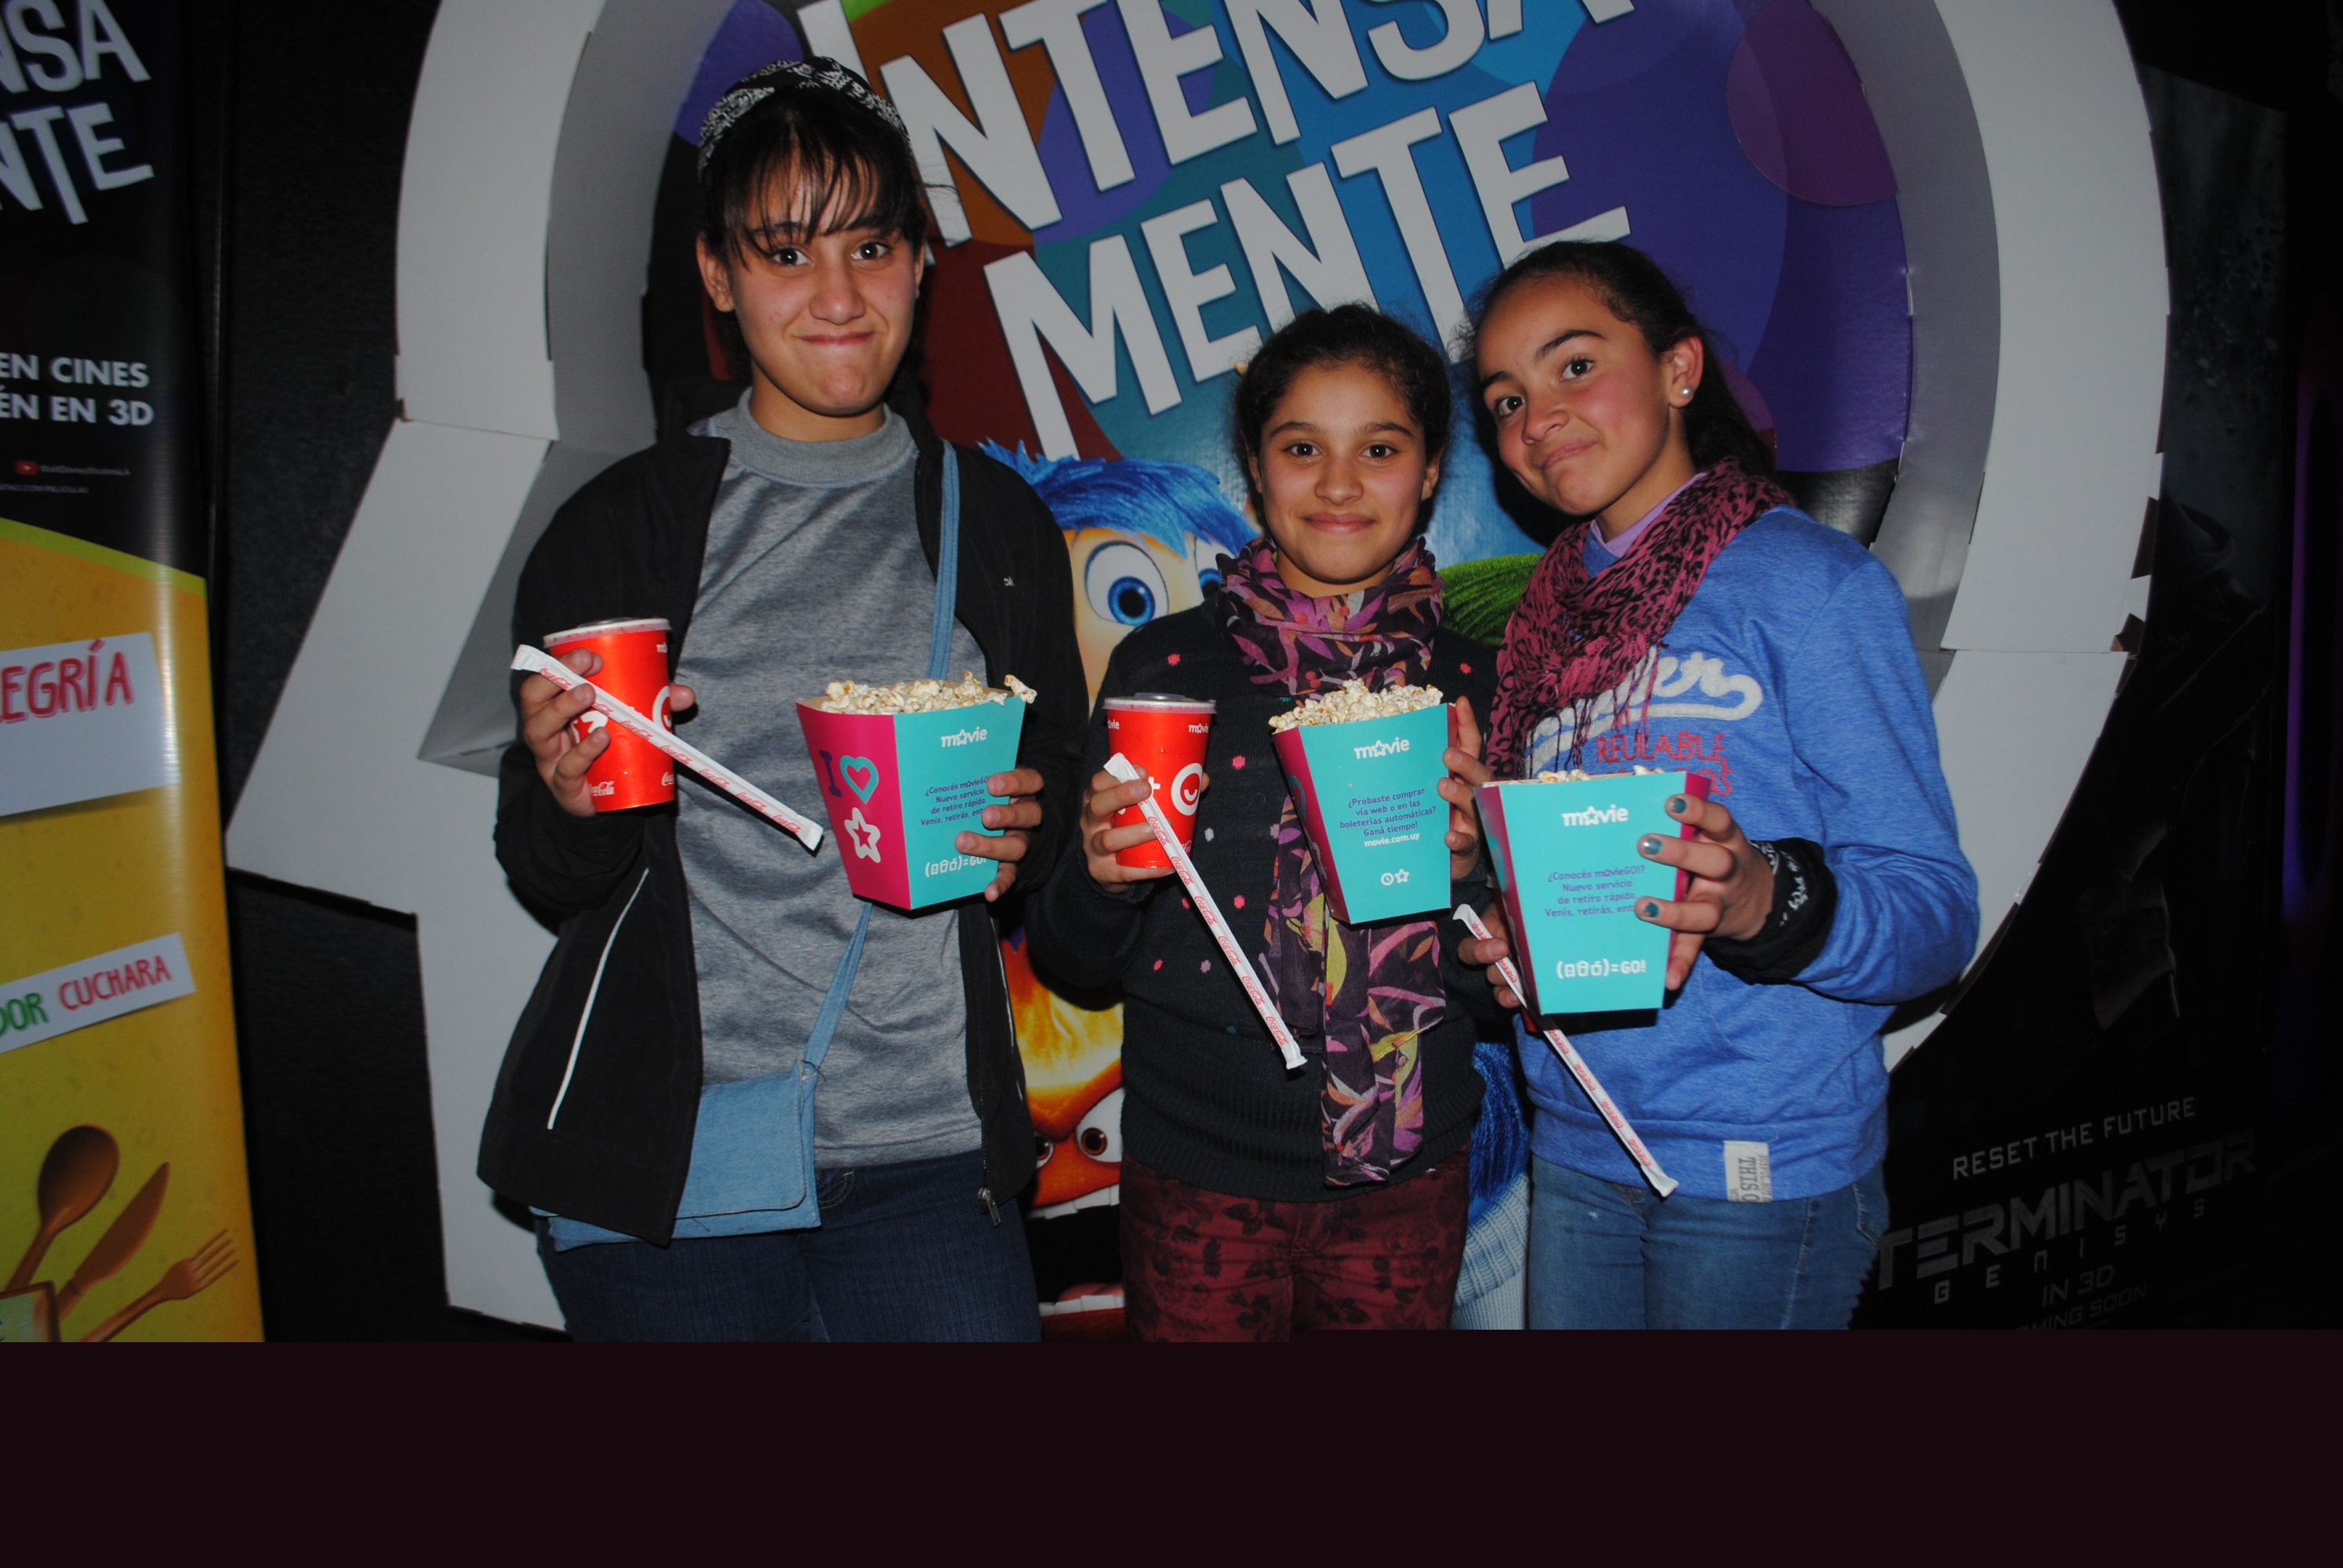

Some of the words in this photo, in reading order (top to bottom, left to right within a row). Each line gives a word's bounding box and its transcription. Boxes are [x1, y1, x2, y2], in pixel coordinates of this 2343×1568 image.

[49, 356, 151, 389] CINES
[49, 394, 98, 424] EN
[107, 398, 155, 426] 3D
[0, 638, 135, 724] EGRÍA
[935, 794, 958, 804] Nuevo
[960, 788, 985, 800] servicio
[943, 803, 963, 813] retiro
[1348, 794, 1390, 808] ¿Probaste
[1392, 788, 1426, 800] comprar
[1371, 804, 1388, 815] web
[1409, 800, 1421, 808] las
[1339, 817, 1382, 829] boleterías
[1384, 806, 1437, 823] automáticas?
[1364, 826, 1386, 837] Ganá
[1387, 821, 1419, 833] tiempo!
[1364, 833, 1420, 848] movie.com.uy
[1563, 884, 1593, 892] Nuevo
[1596, 879, 1633, 890] servicio
[1557, 896, 1570, 905] de
[1573, 895, 1602, 904] retiro
[59, 955, 173, 1011] CUCHARA
[1953, 1137, 2040, 1181] RESET
[2045, 1122, 2094, 1154] THE
[2103, 1095, 2196, 1140] FUTURE
[1738, 1156, 1760, 1191] THIS
[1877, 1127, 2258, 1291] TERMINATOR
[2041, 1277, 2069, 1308] IN
[2078, 1263, 2116, 1296] 3D
[2088, 1282, 2146, 1319] SOON
